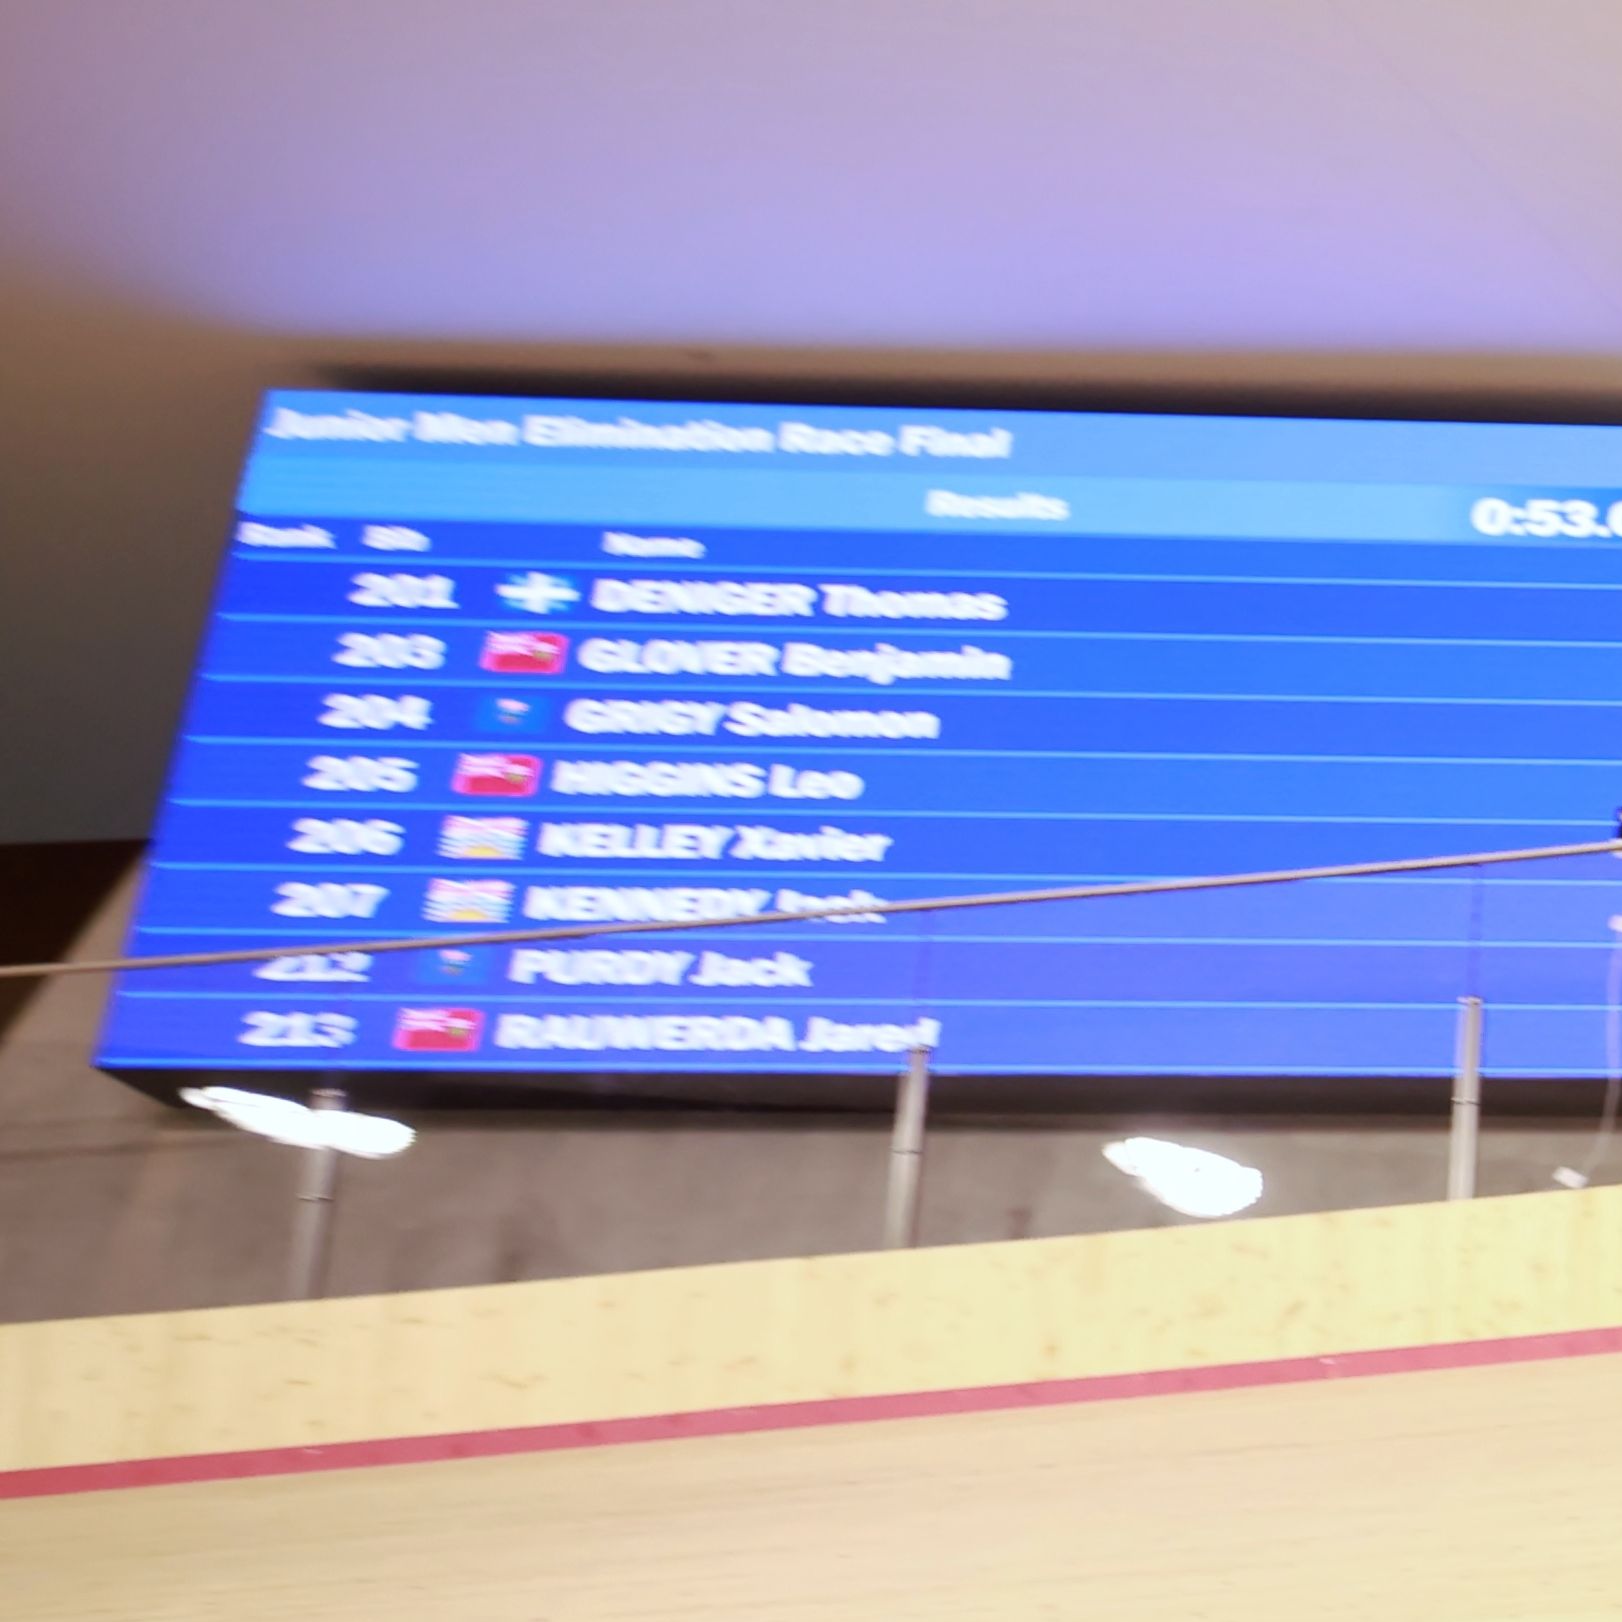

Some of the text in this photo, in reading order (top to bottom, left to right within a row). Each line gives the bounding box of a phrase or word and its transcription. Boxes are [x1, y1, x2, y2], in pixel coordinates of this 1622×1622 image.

[266, 408, 1013, 458] Junior Men Elimination Race Final
[925, 489, 1070, 520] Results
[347, 572, 462, 609] 201
[820, 583, 1008, 620] Thomas
[578, 638, 779, 676] GLOVER
[781, 642, 1012, 685] Benjamin
[316, 693, 434, 730] 204
[723, 702, 941, 739] Salomon
[300, 755, 865, 800] 205 HIGGINS Leo
[285, 818, 893, 861] 206 KELLEY Xavier
[270, 882, 391, 918] 207
[523, 886, 772, 922] KENNEDY
[507, 949, 694, 986] PURDY
[688, 950, 813, 987] Jack
[236, 1011, 941, 1052] 213 RAUWERDA Jared
